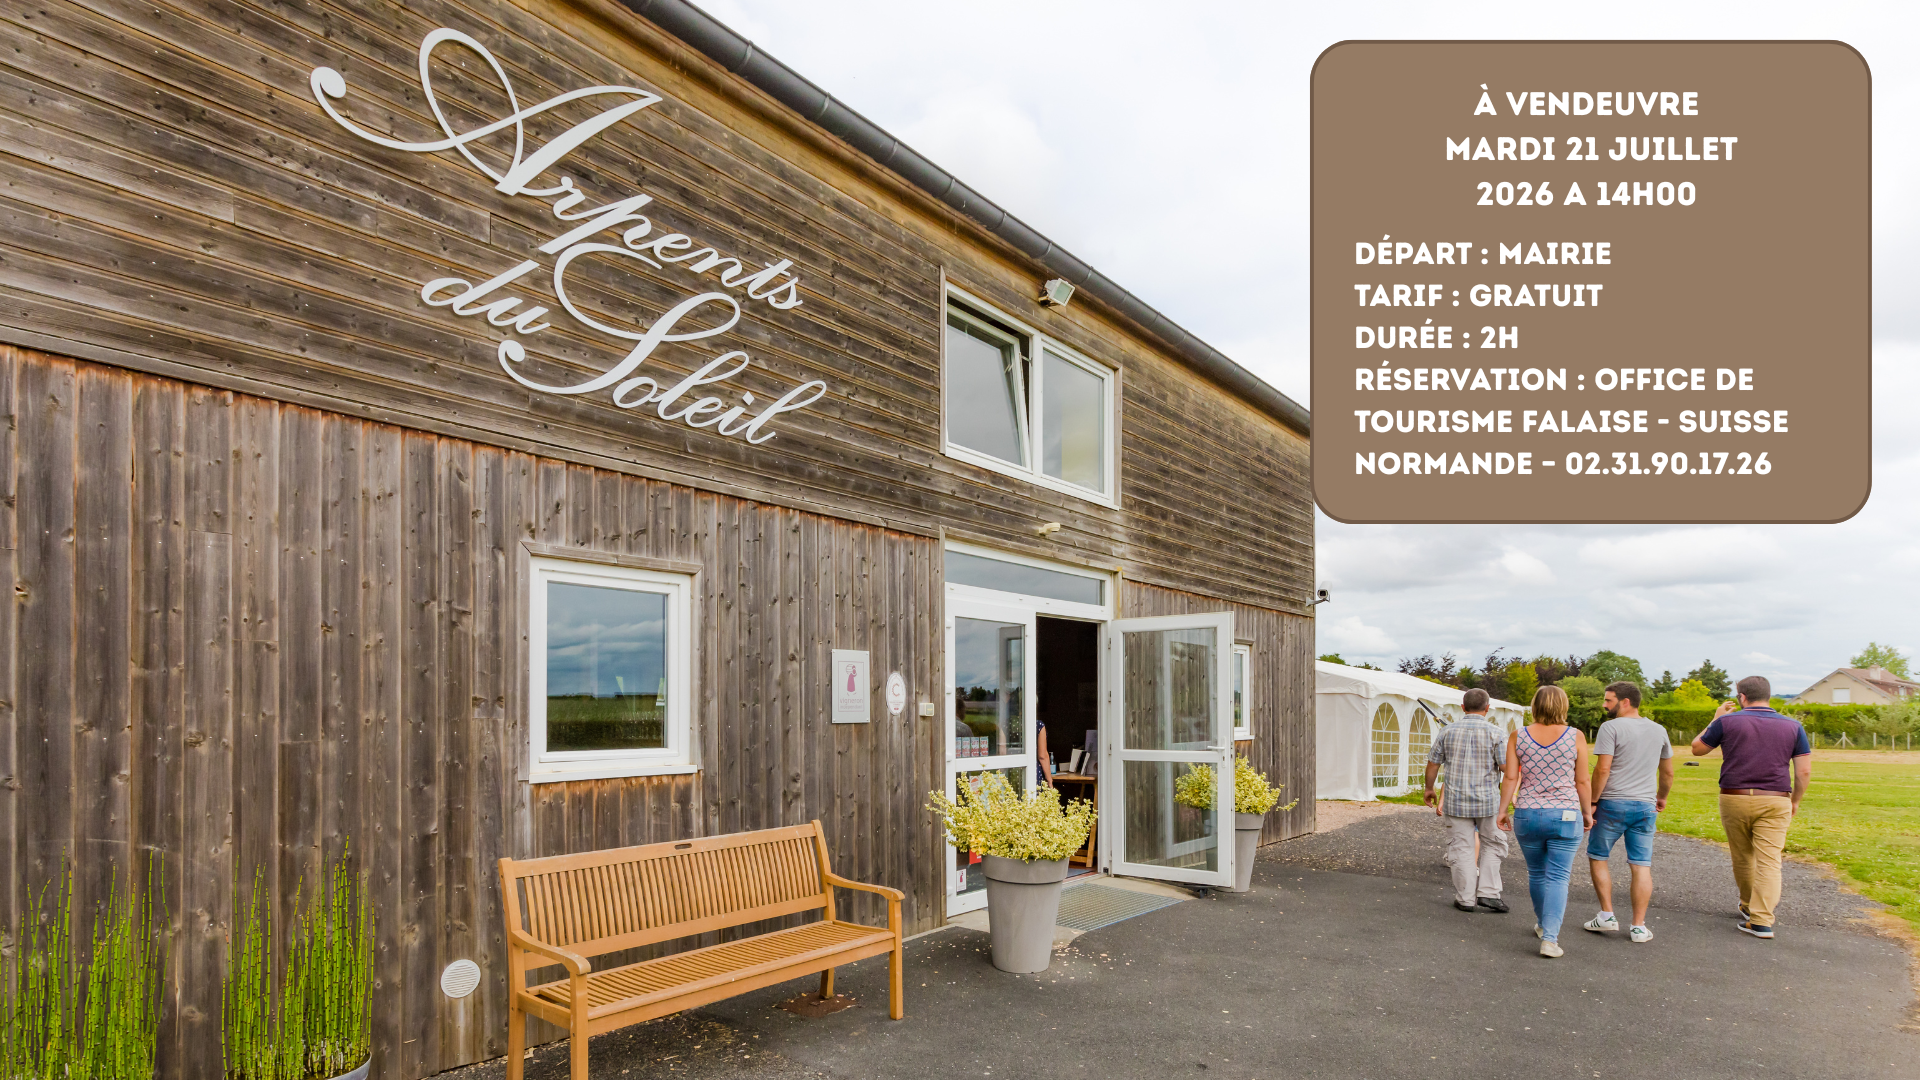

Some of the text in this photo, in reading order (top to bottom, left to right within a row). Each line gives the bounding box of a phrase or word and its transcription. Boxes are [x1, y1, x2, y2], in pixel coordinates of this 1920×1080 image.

[310, 28, 803, 310] Arpents
[421, 243, 827, 445] du Soleil
